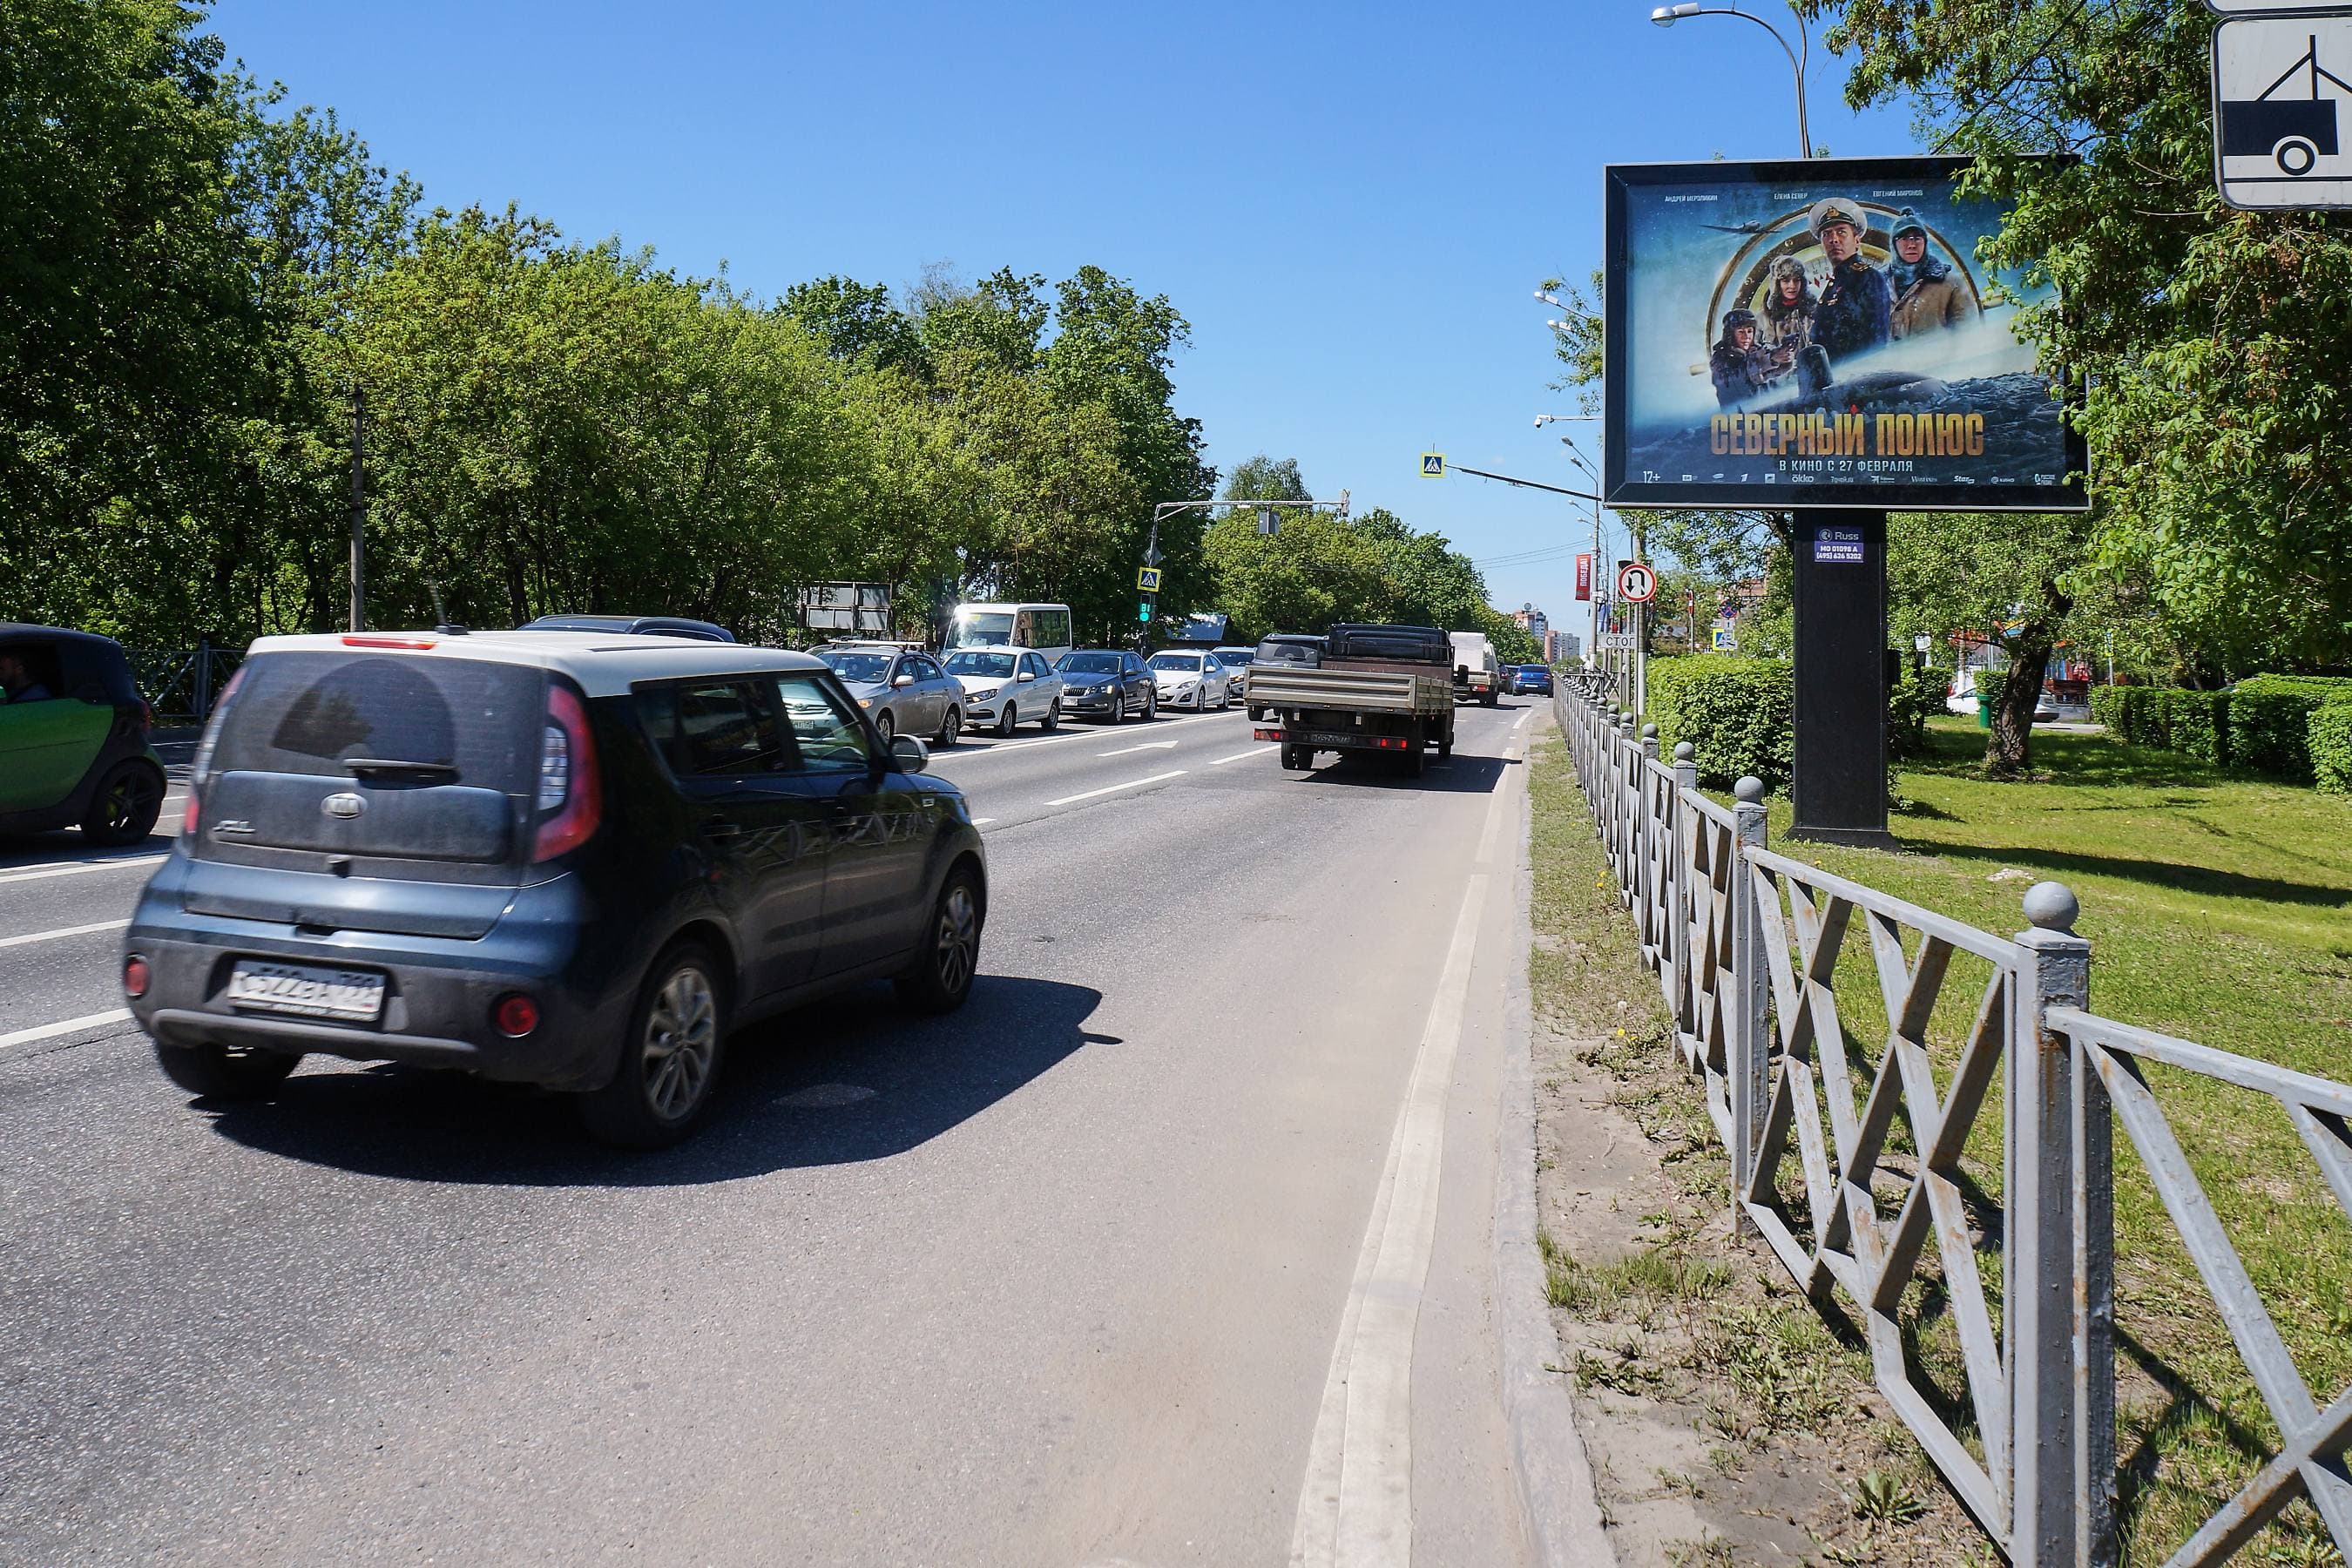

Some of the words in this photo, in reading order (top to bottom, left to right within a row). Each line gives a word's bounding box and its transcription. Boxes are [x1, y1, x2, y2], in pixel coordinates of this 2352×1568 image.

[1710, 406, 1866, 456] СЕВЕРНЫЙ
[1876, 413, 1984, 456] ПОЛЮС
[1779, 461, 1786, 472] В
[1791, 461, 1822, 472] КИНО
[1828, 460, 1835, 472] С
[1839, 460, 1853, 471] 27
[1857, 460, 1913, 472] ФЕВРАЛЯ
[1643, 470, 1660, 484] 12+
